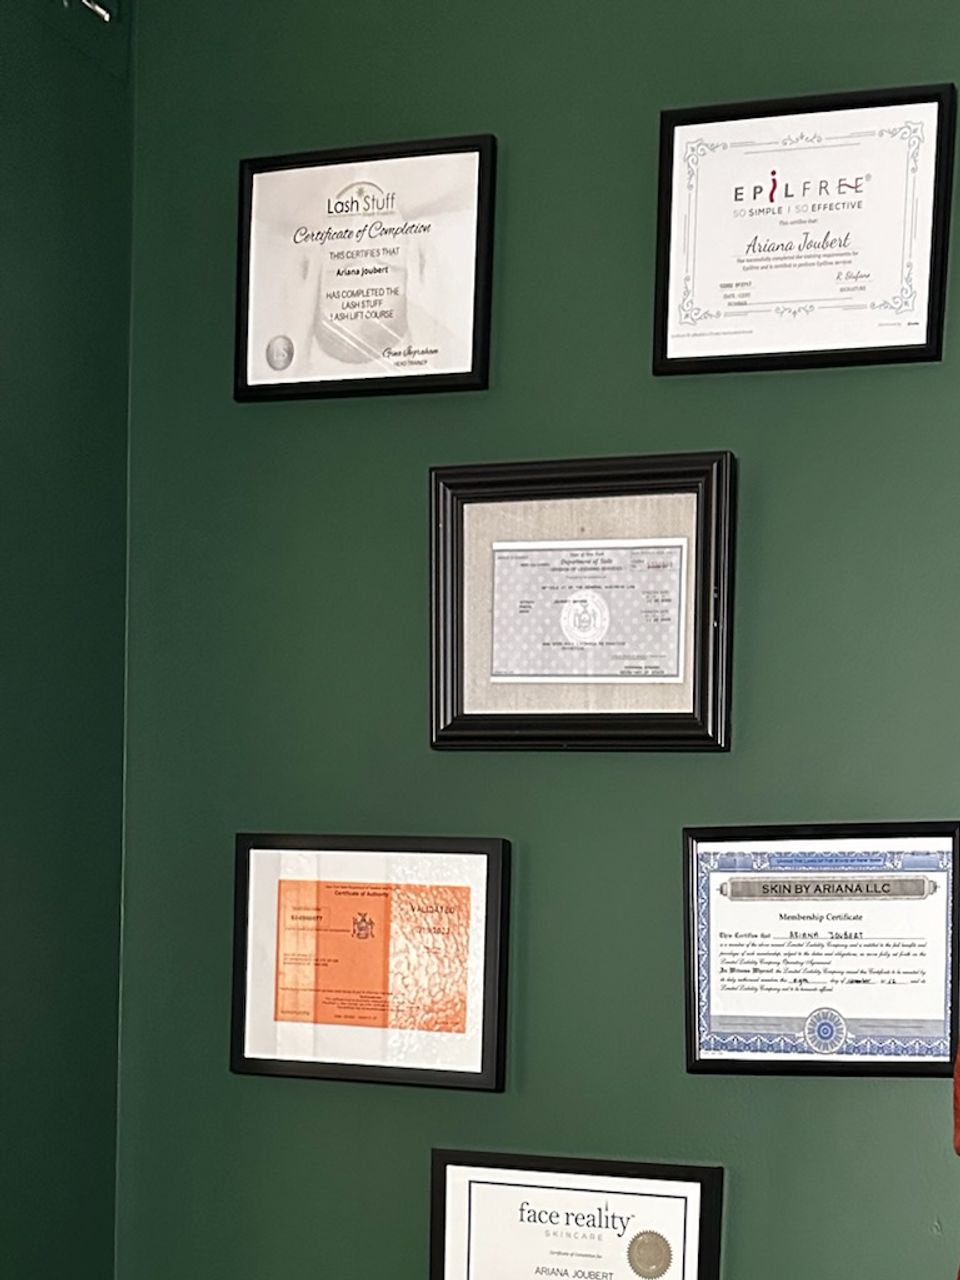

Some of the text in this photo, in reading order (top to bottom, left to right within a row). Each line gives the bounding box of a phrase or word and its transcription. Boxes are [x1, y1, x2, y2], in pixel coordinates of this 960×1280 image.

[327, 192, 396, 214] Lash Stuff
[733, 200, 863, 218] SO SIMPLE SO EFFECTIVE
[293, 220, 432, 245] Certificate of Completion
[745, 230, 851, 255] Ariana Joubert
[329, 246, 400, 260] THIS CERTIFIES THAT
[336, 266, 389, 277] Ariana Joubert
[326, 286, 400, 299] HAS COMPLETED THE
[341, 299, 382, 310] LASH STUFF
[364, 309, 394, 319] COURSE
[761, 883, 891, 895] SKIN BY ARIANA LLC
[779, 912, 863, 922] Membership Certificate
[518, 1201, 631, 1238] face reality
[544, 1229, 603, 1241] SKINCARE
[534, 1266, 615, 1280] ARIANA JOUBERT
